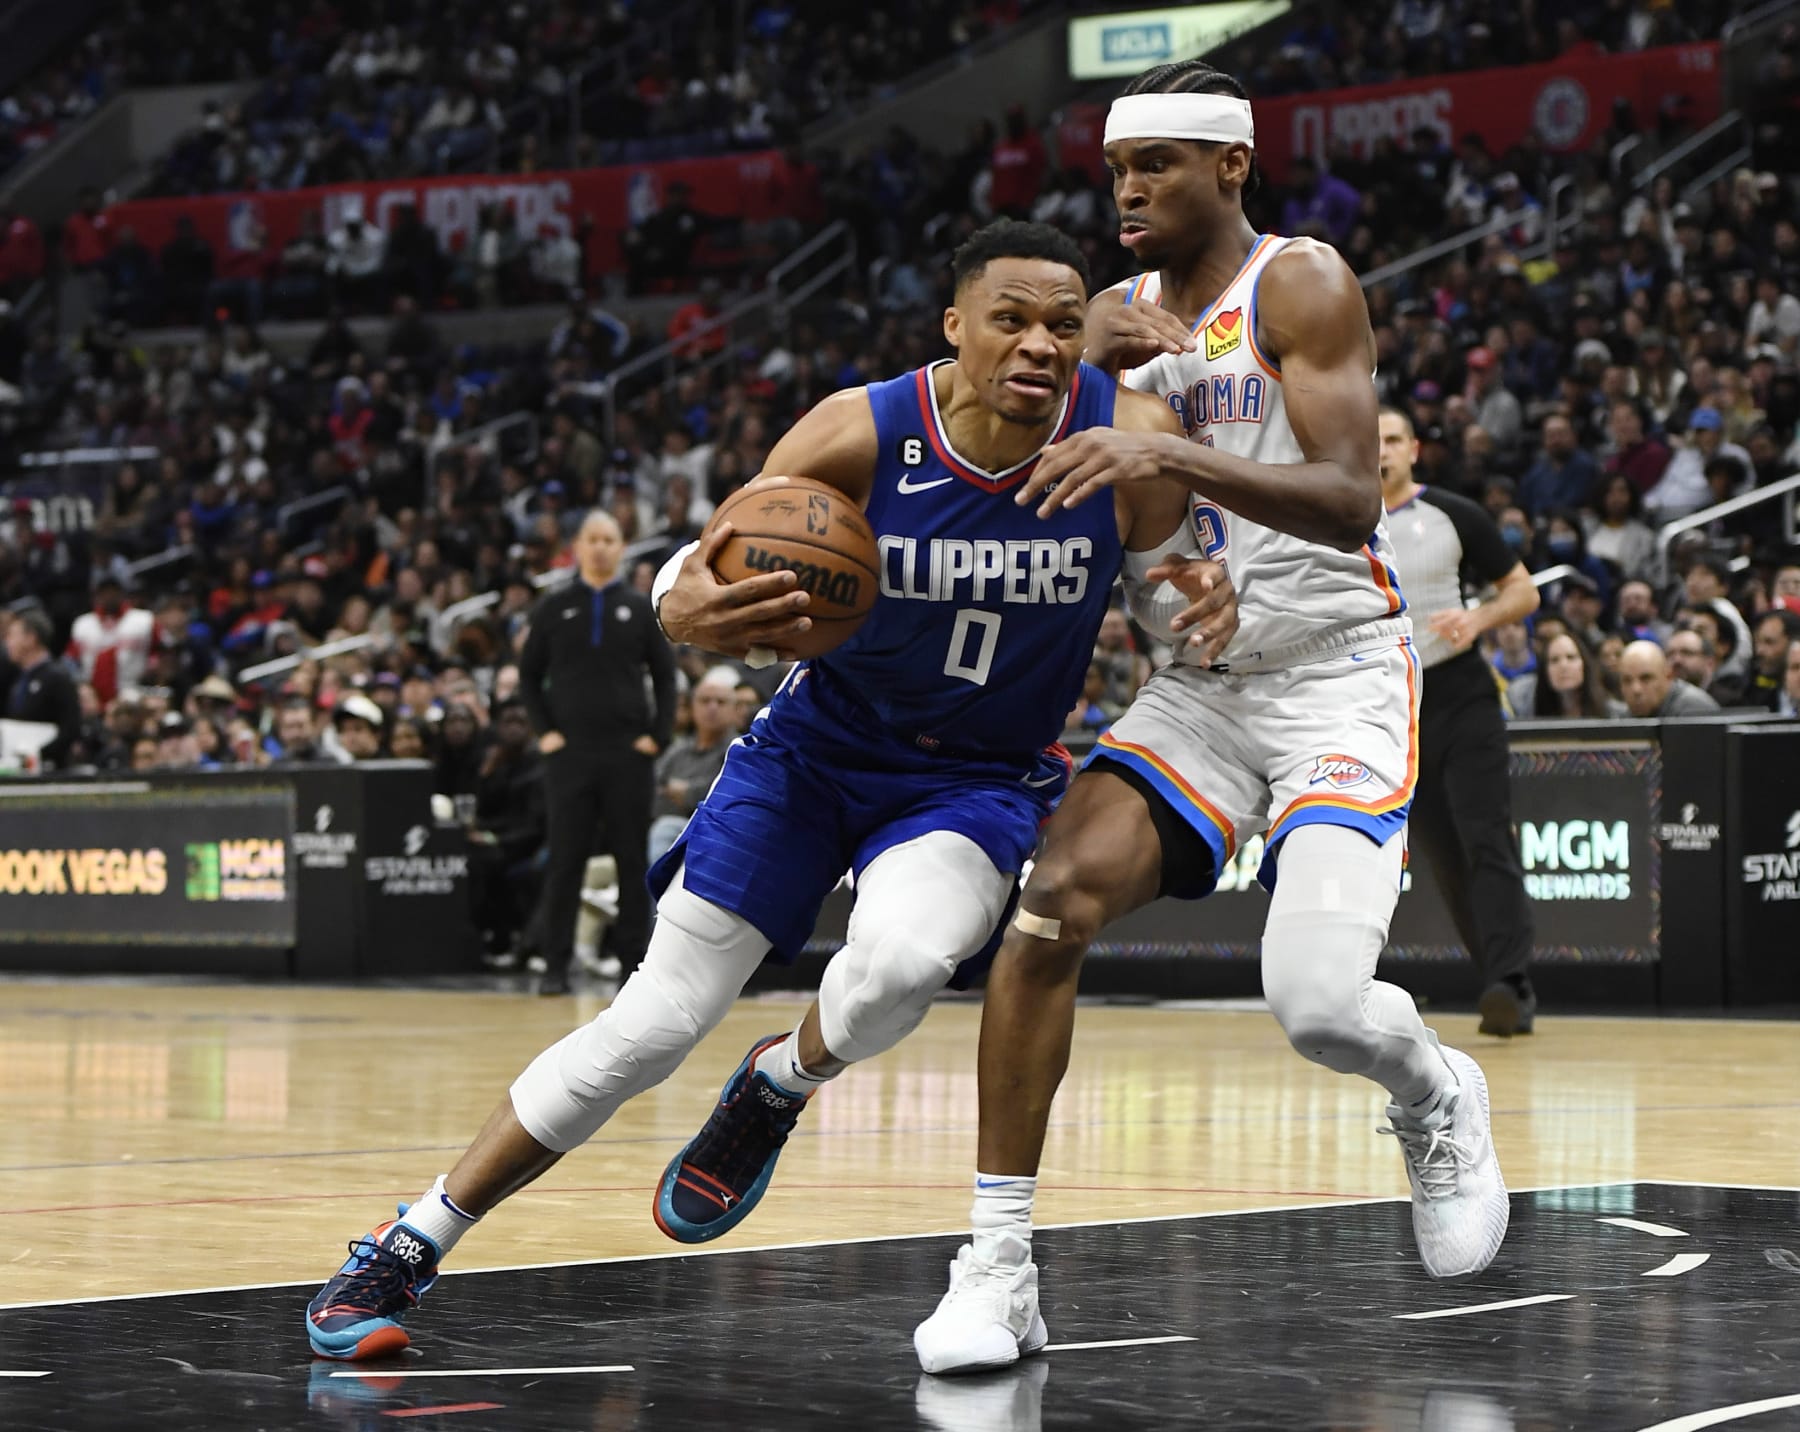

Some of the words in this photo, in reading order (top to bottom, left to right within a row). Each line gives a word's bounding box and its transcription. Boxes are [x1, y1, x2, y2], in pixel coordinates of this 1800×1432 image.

[903, 439, 922, 465] 6
[877, 534, 1093, 605] CLIPPERS
[944, 608, 1002, 686] 0
[1311, 760, 1364, 785] OKC
[219, 837, 286, 878] MGM
[1520, 819, 1631, 871] MGM
[0, 848, 68, 895] OOK
[68, 847, 168, 895] VEGAS
[1523, 873, 1631, 900] REWARDS
